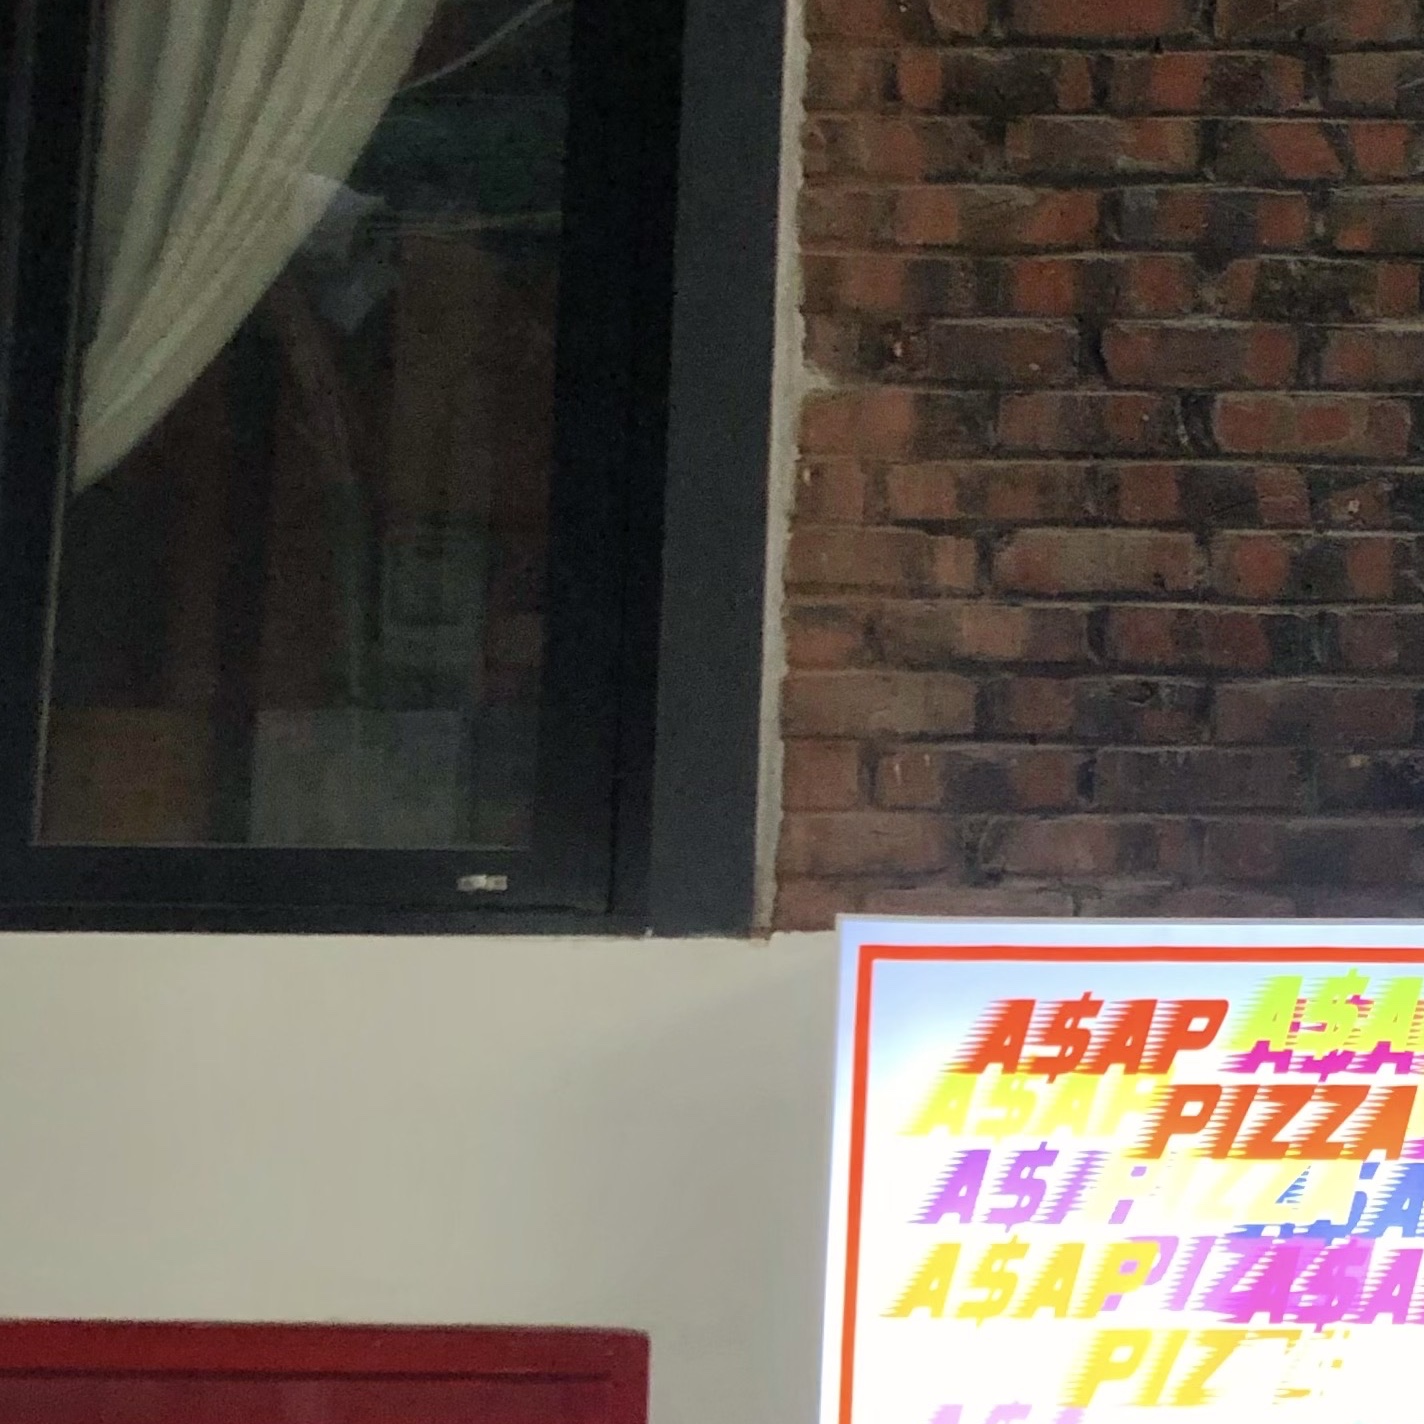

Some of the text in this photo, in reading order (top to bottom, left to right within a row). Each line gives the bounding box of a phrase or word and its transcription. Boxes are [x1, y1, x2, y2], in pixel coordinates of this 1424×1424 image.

[940, 990, 1230, 1084] A$AP
[1126, 1084, 1420, 1160] PIZZA
[880, 1235, 1162, 1328] A$AP
